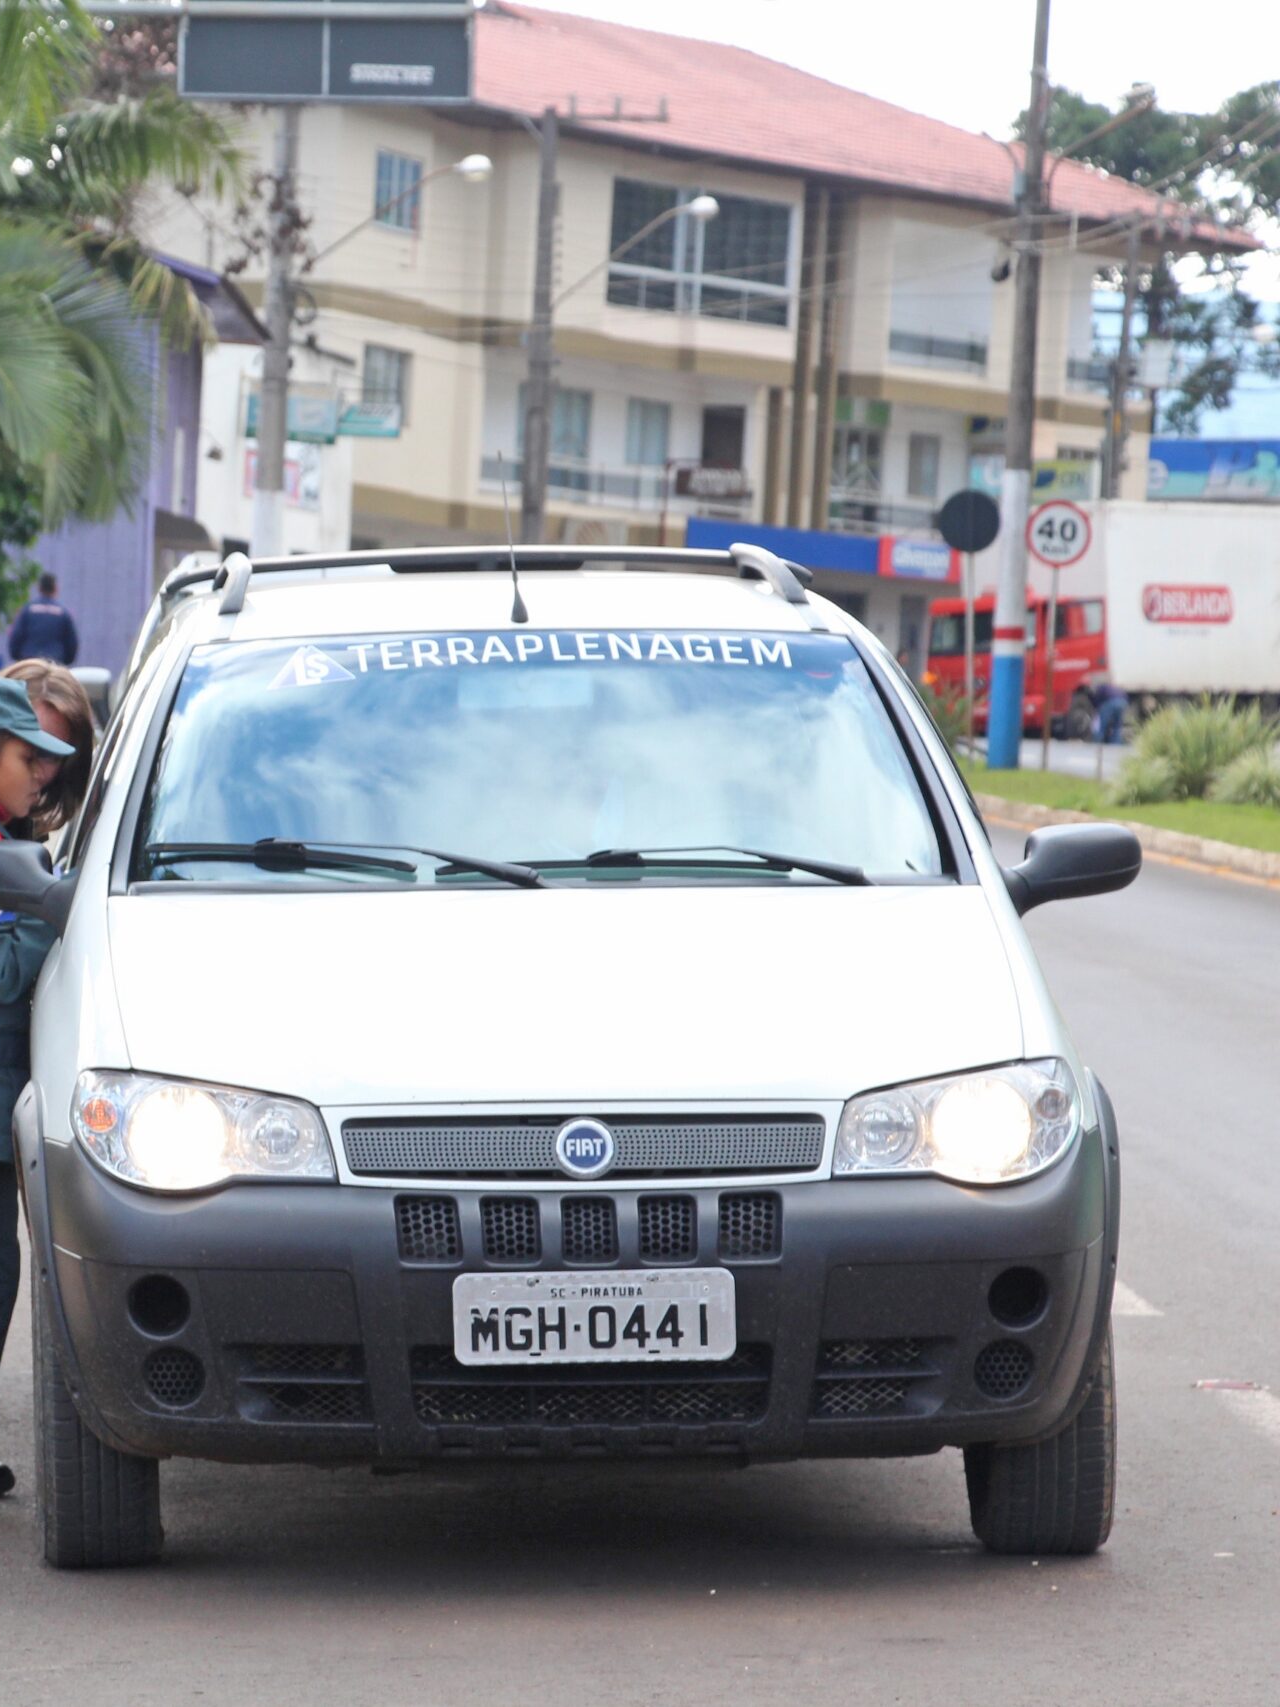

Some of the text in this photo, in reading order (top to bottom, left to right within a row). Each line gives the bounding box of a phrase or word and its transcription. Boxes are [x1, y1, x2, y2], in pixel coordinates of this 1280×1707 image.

[1037, 517, 1077, 542] 40
[346, 633, 793, 673] TERRAPLENAGEM
[566, 1138, 603, 1157] FIAT
[550, 1287, 566, 1298] SC
[581, 1286, 643, 1297] PIRATUBA
